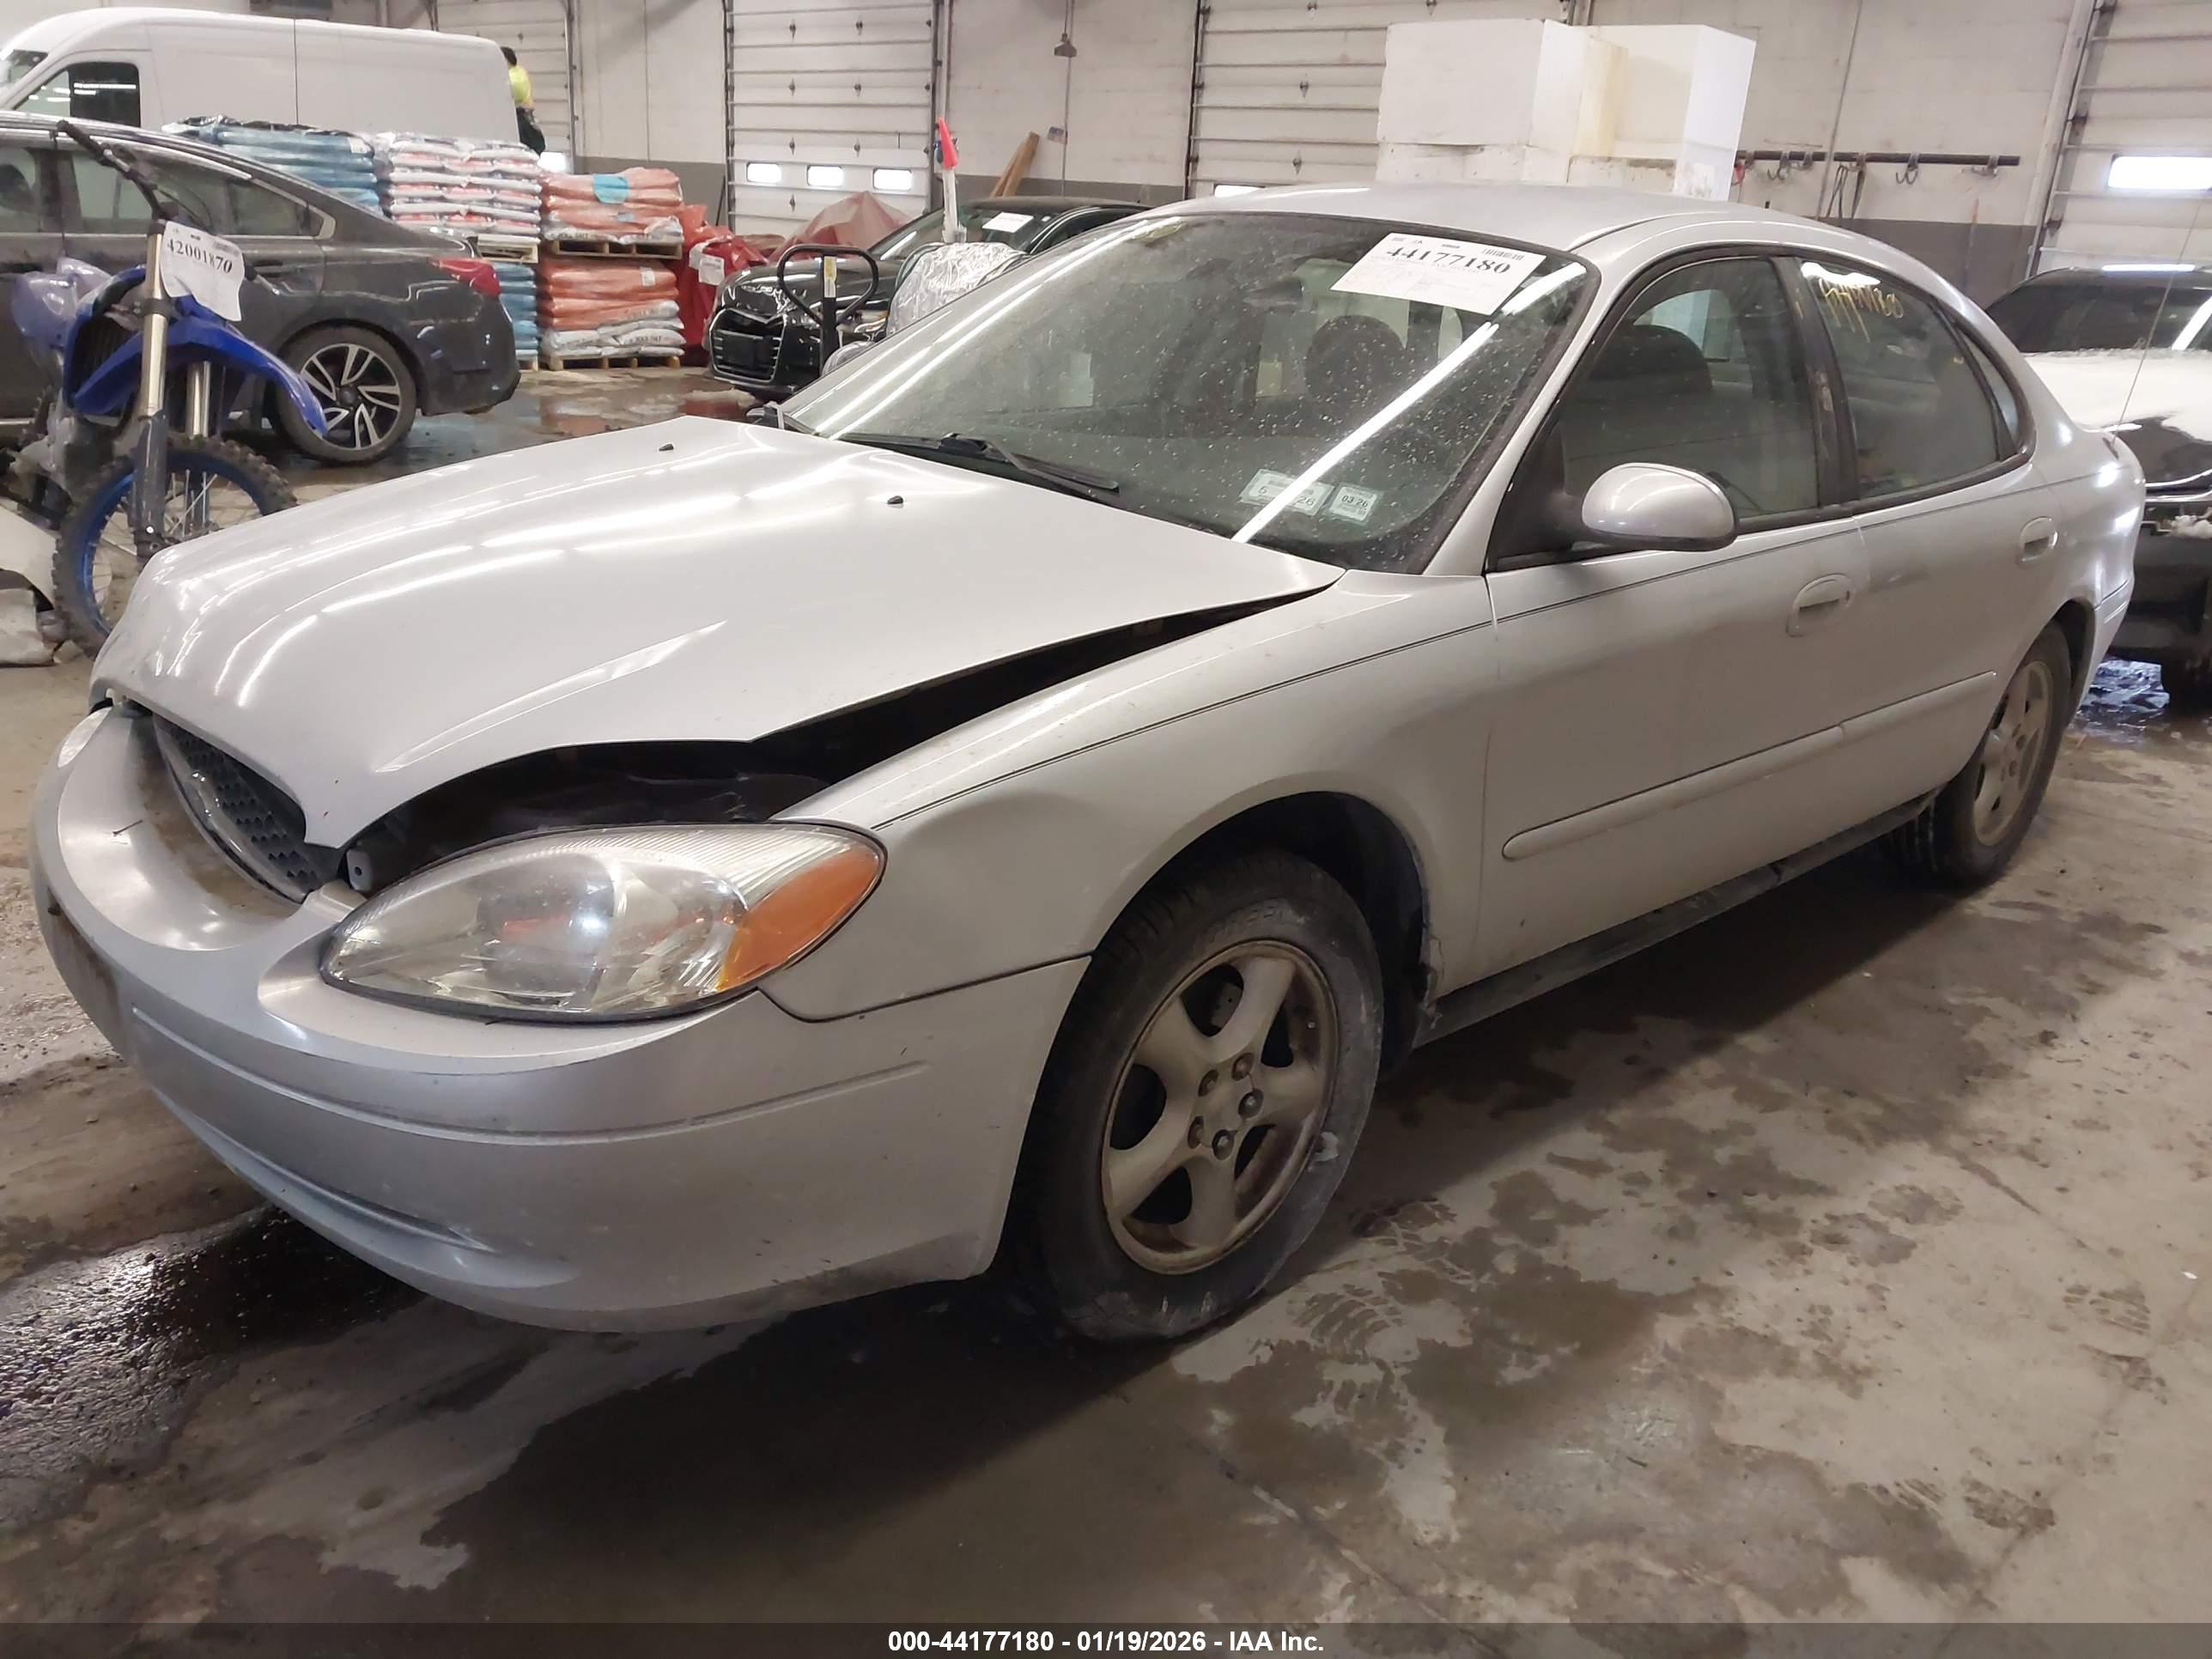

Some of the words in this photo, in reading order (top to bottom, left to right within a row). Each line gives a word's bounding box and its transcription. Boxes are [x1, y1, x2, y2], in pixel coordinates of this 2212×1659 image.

[167, 238, 233, 273] 42001870
[1386, 246, 1511, 274] 44177180
[1297, 495, 1315, 506] 26
[1341, 495, 1355, 503] 03
[1356, 498, 1369, 508] 26
